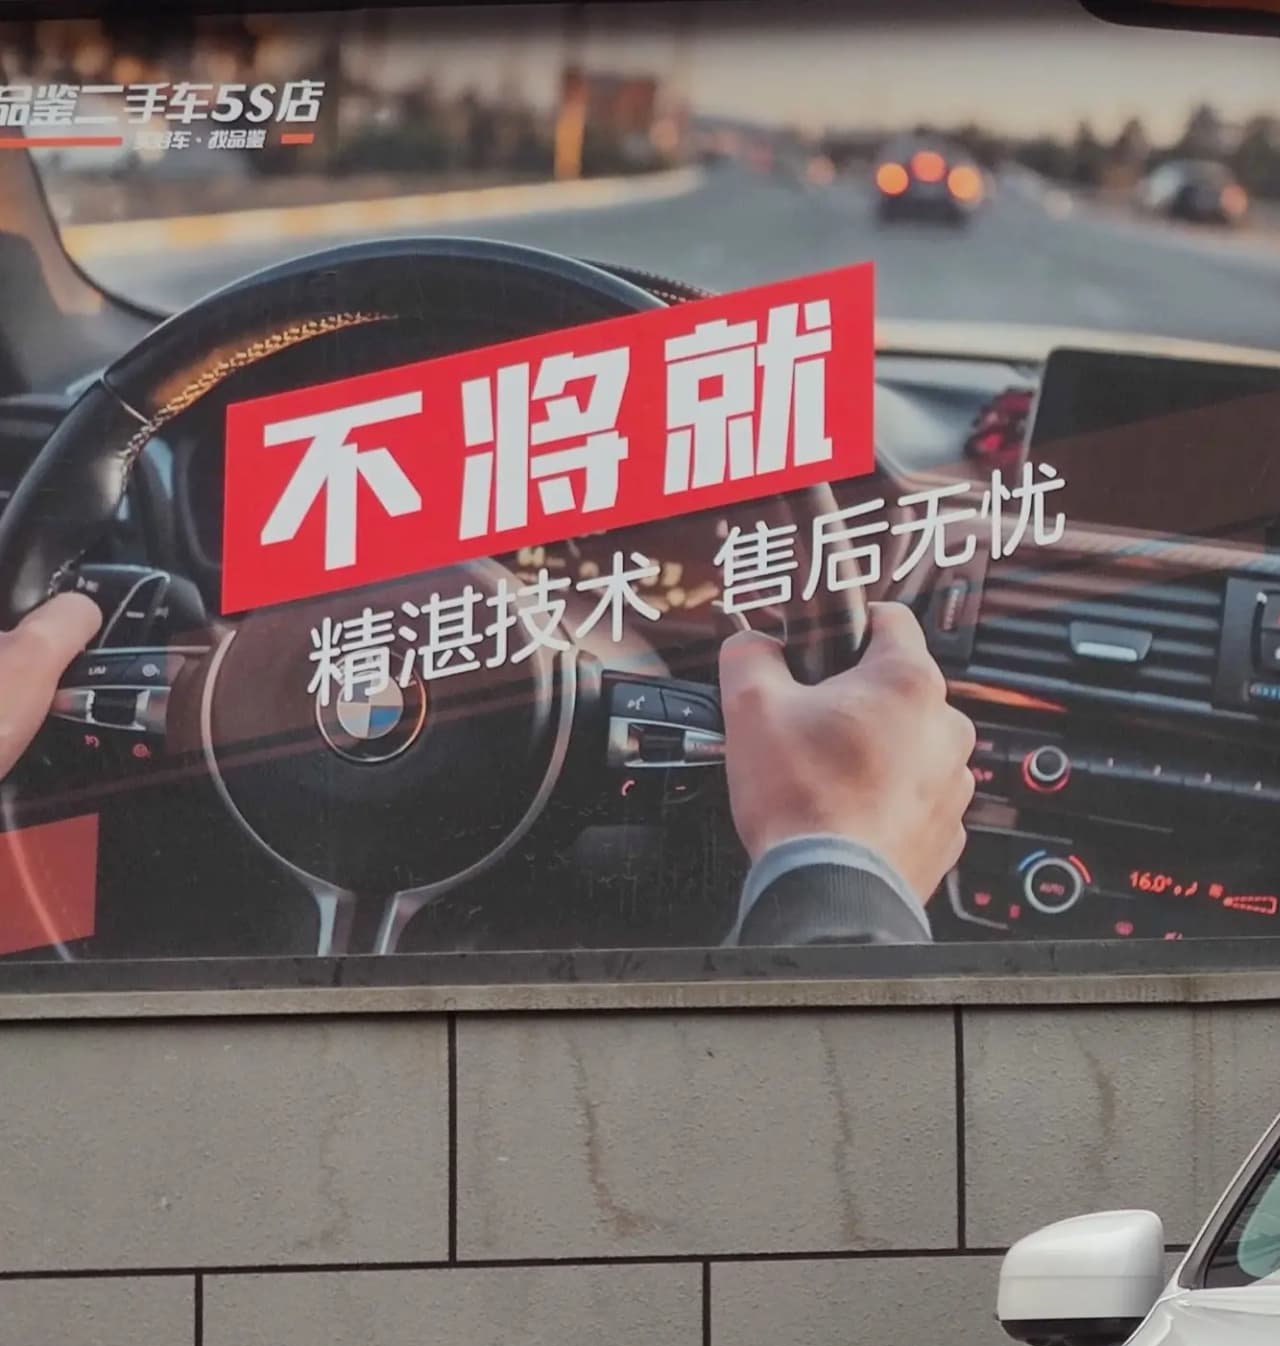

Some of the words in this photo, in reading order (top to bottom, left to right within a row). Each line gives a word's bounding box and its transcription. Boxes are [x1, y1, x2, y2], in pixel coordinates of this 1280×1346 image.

[134, 129, 267, 150] 车·找品鉴
[259, 297, 833, 572] 不将就
[306, 551, 663, 708] 精湛技术
[712, 462, 1066, 615] 售后无忧
